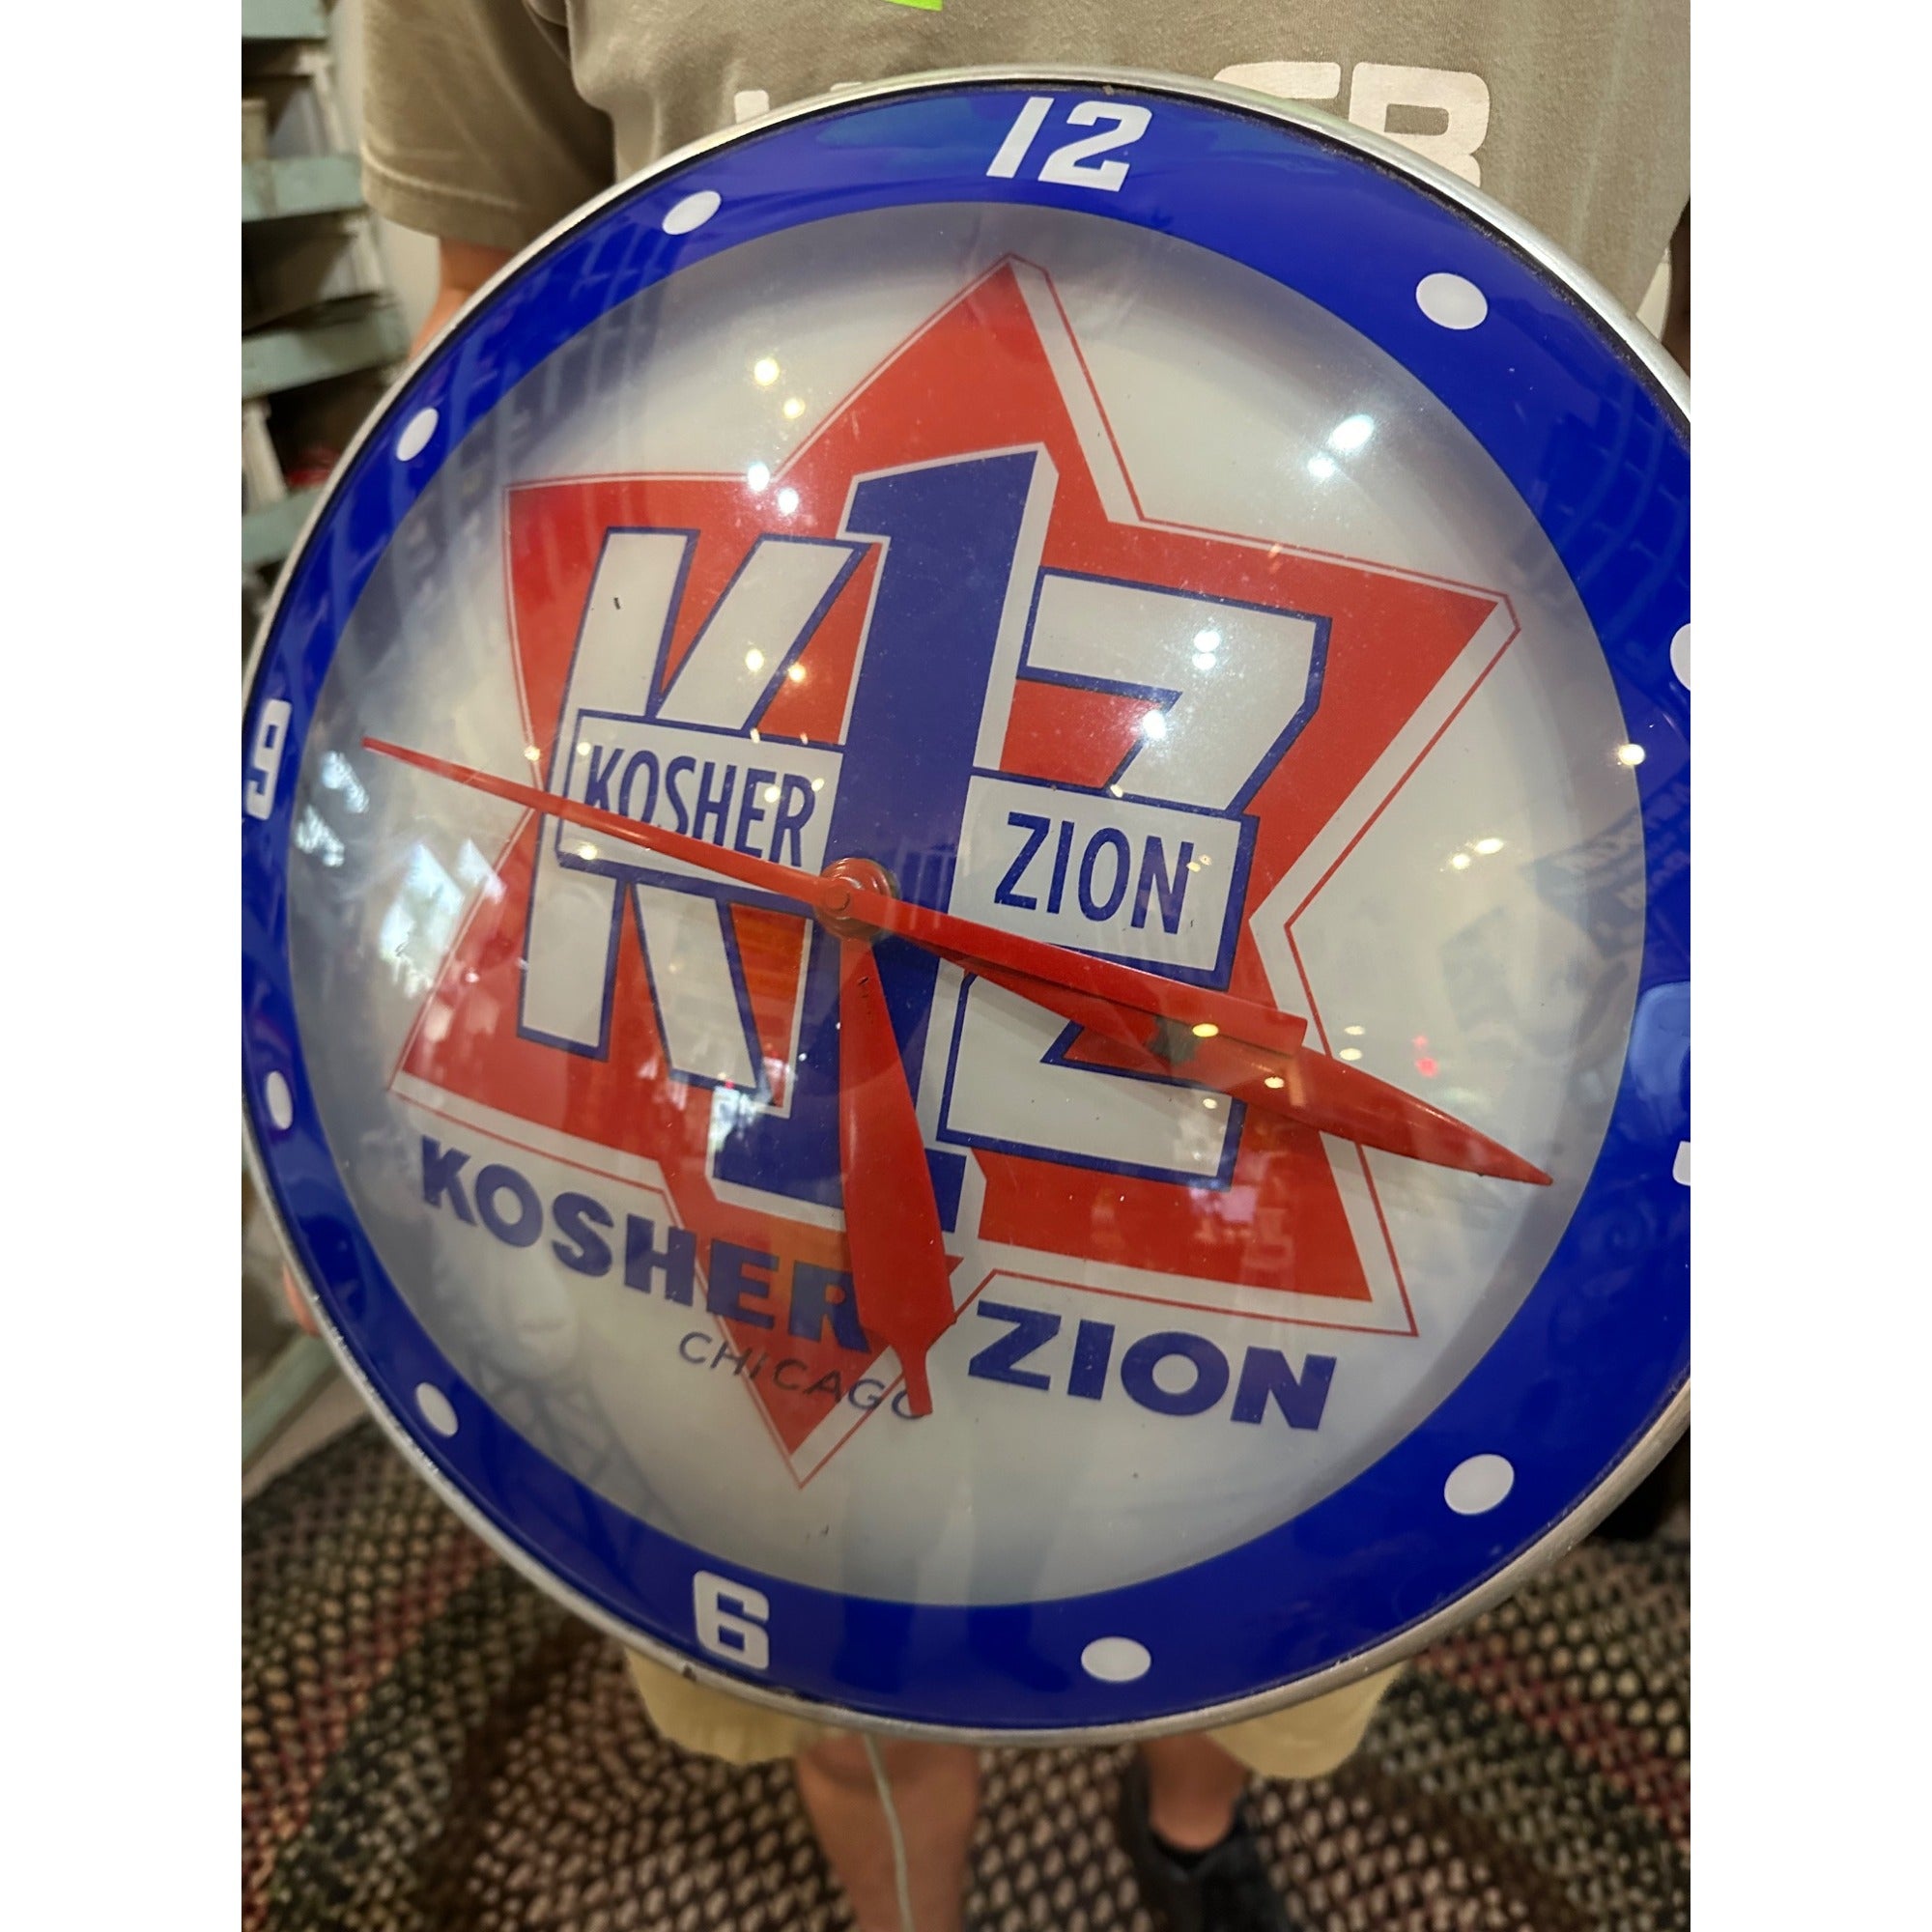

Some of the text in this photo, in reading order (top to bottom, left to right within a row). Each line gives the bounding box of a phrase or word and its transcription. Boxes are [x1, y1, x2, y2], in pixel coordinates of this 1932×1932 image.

[986, 97, 1152, 192] 12
[245, 698, 293, 820] 9
[583, 745, 1195, 935] KOSHER ZION
[418, 1135, 1338, 1431] KOSHER ZION
[693, 1569, 770, 1670] 6
